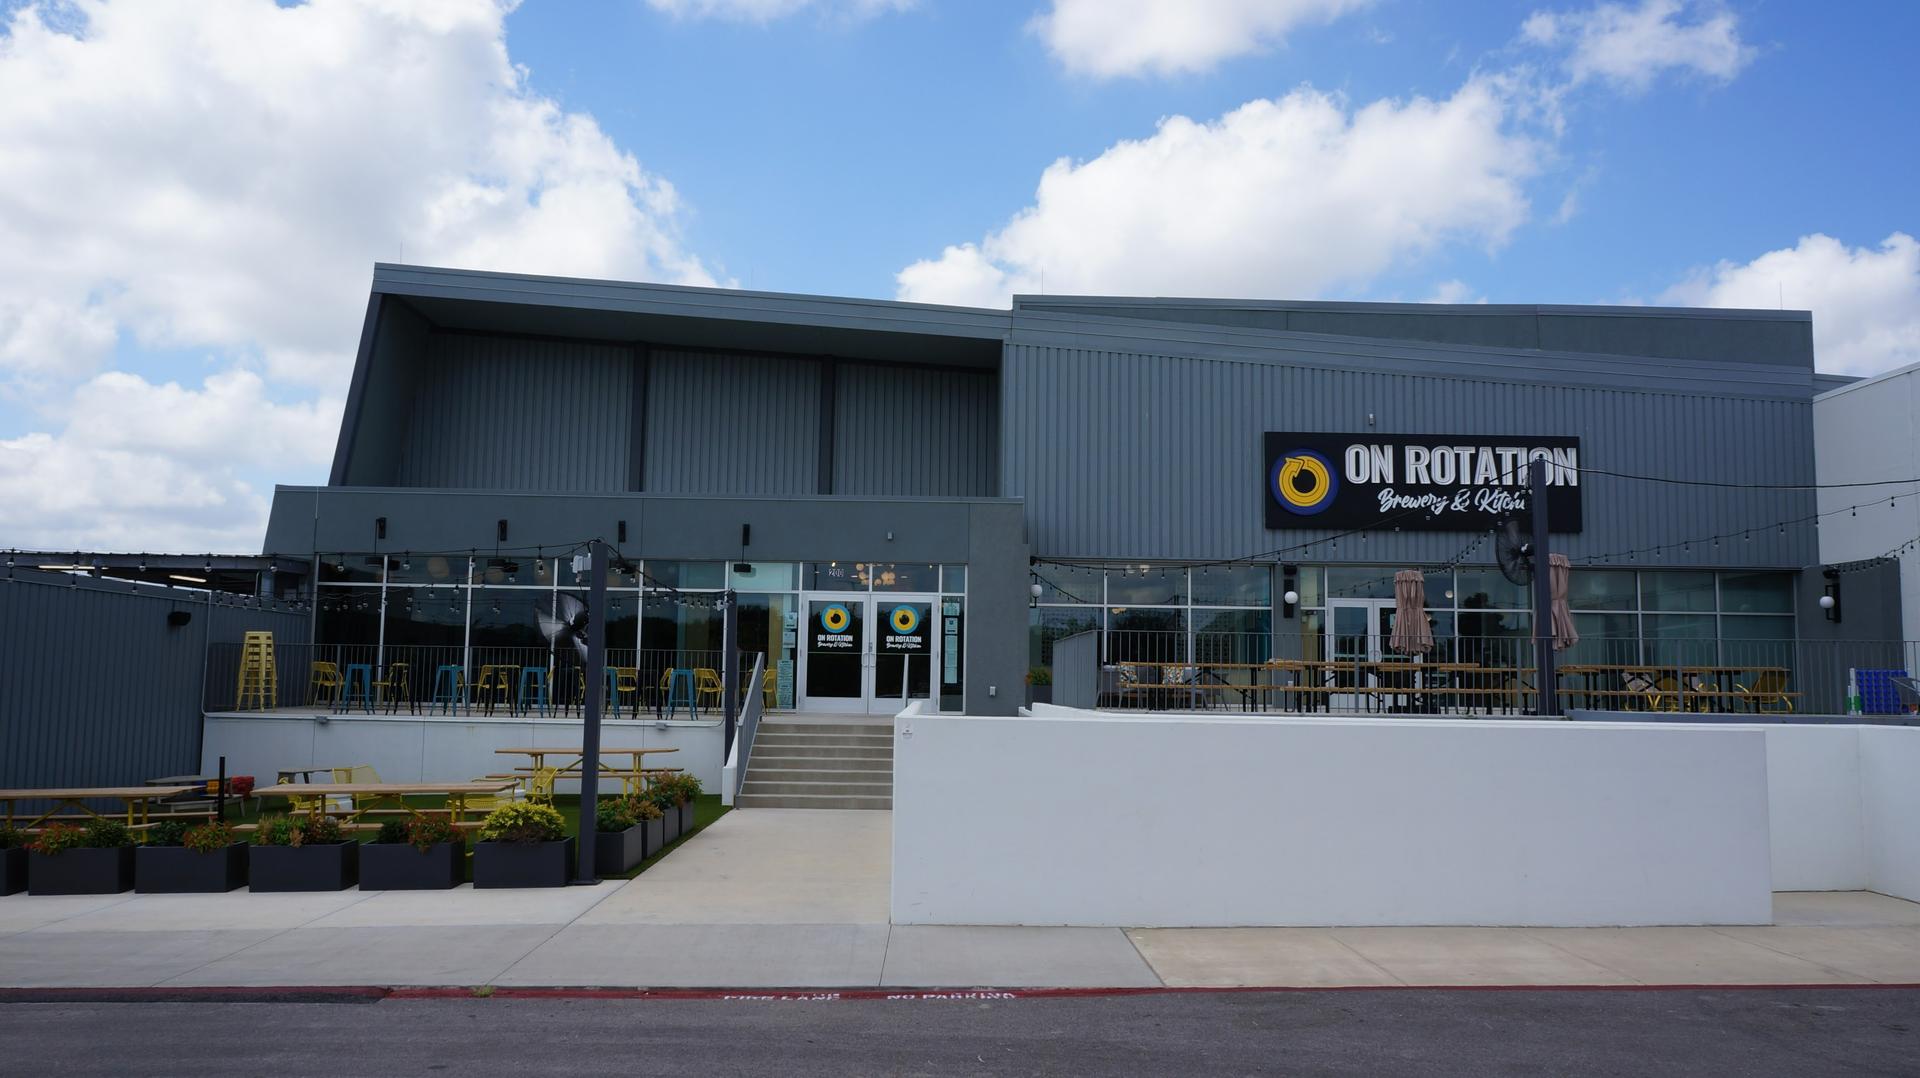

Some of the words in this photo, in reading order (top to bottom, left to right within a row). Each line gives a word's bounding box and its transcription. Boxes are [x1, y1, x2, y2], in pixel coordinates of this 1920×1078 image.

[1345, 443, 1394, 484] ON
[1404, 445, 1578, 487] ROTATION
[1377, 487, 1449, 515] Brewery
[1450, 488, 1470, 513] &
[826, 634, 854, 642] ROTATION
[895, 635, 922, 643] ROTATION
